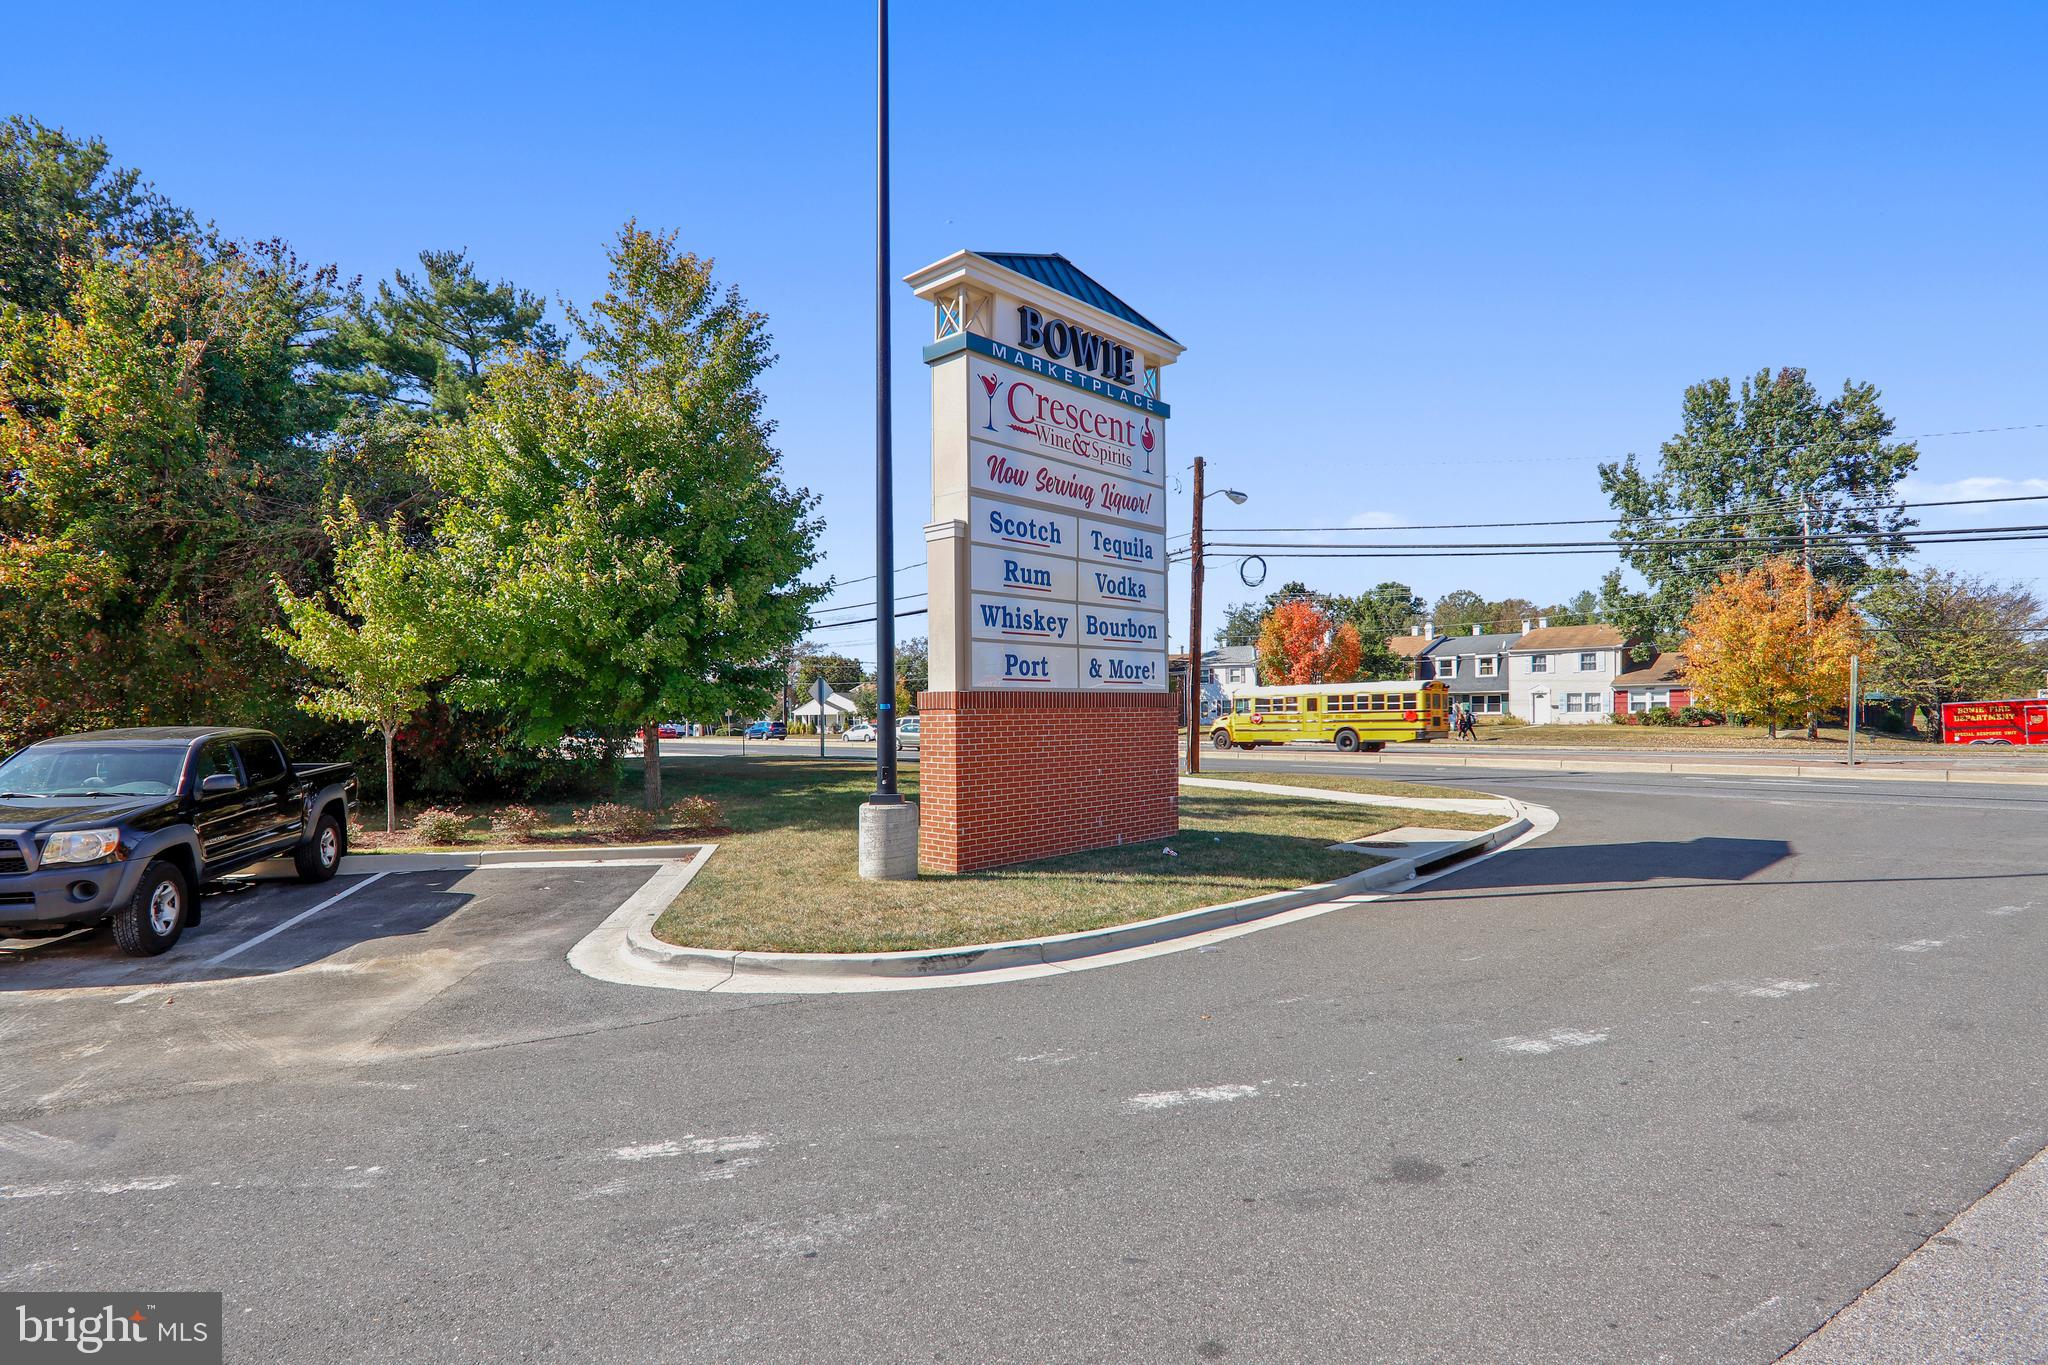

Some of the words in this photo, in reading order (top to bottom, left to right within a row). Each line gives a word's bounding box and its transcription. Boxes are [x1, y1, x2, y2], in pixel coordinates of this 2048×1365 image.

[1017, 305, 1135, 386] BOWIE
[992, 342, 1154, 411] MARKETPLACE
[1007, 381, 1137, 447] Crescent
[986, 454, 1029, 487] Now
[1036, 467, 1096, 508] Serving
[1101, 482, 1152, 515] Liquor!
[990, 510, 1061, 544] Scotch
[1091, 530, 1153, 560] Tequila
[1004, 560, 1051, 586] Rum
[1095, 572, 1147, 598] Vodka
[980, 604, 1069, 638] Whiskey
[1086, 615, 1157, 639] Bourbon
[1005, 654, 1049, 677] Port
[1089, 658, 1102, 678] &
[1109, 659, 1155, 679] More!
[1953, 713, 2016, 722] DEPARTMENT
[1989, 705, 2011, 713] FIRE
